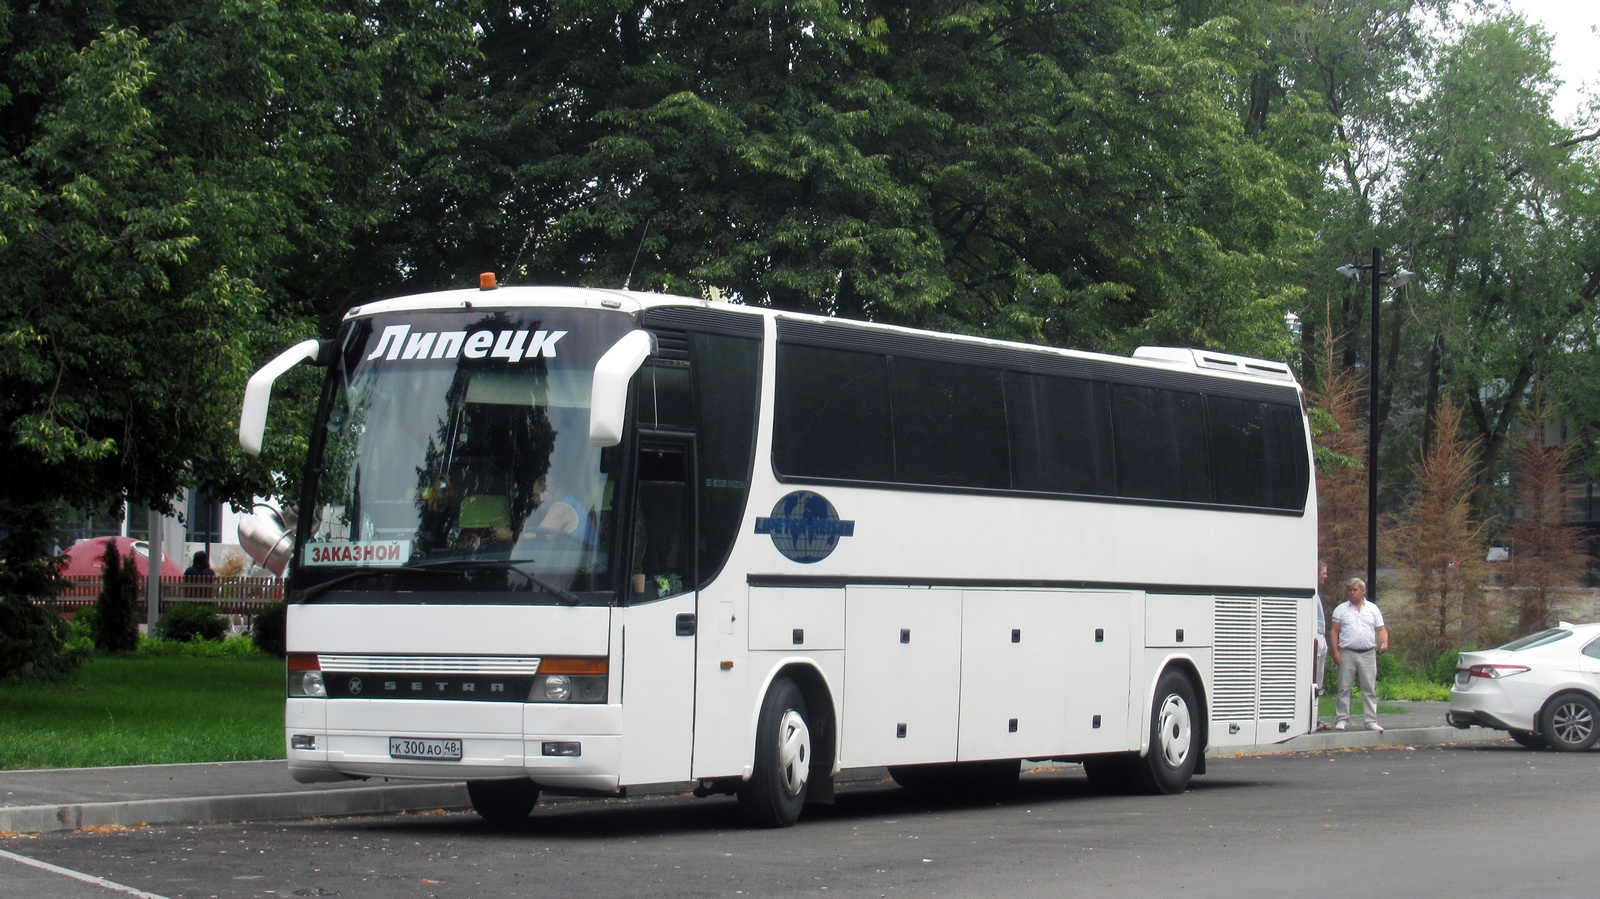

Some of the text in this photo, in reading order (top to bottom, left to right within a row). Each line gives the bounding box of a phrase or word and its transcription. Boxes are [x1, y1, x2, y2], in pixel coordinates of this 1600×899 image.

[367, 324, 568, 362] Липецк
[312, 541, 400, 562] ЗАКАЗНОЙ
[384, 682, 505, 692] SETRA
